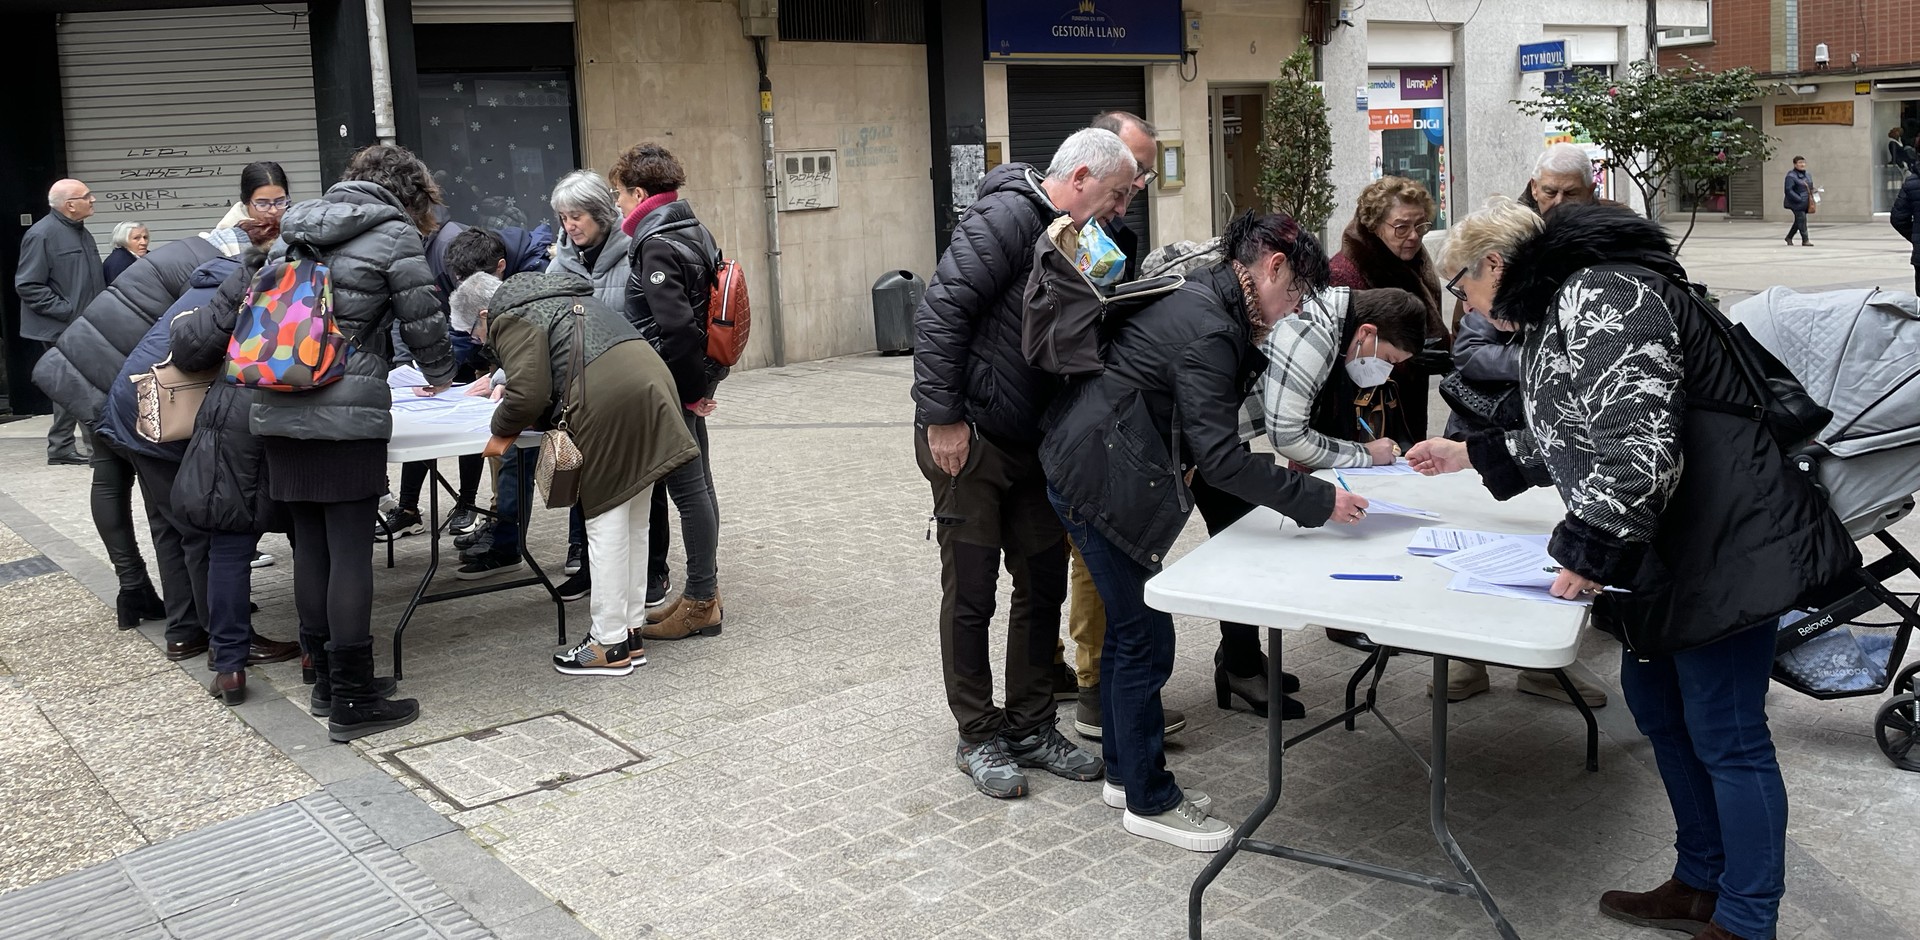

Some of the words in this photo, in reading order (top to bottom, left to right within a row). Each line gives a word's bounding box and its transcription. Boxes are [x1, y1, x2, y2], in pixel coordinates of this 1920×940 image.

[1052, 24, 1095, 38] GESTORÍA
[1097, 26, 1126, 38] LLANO
[1250, 40, 1257, 55] 6
[1385, 110, 1400, 125] ria
[1413, 119, 1440, 130] DIGI
[1797, 613, 1834, 637] Beloved
